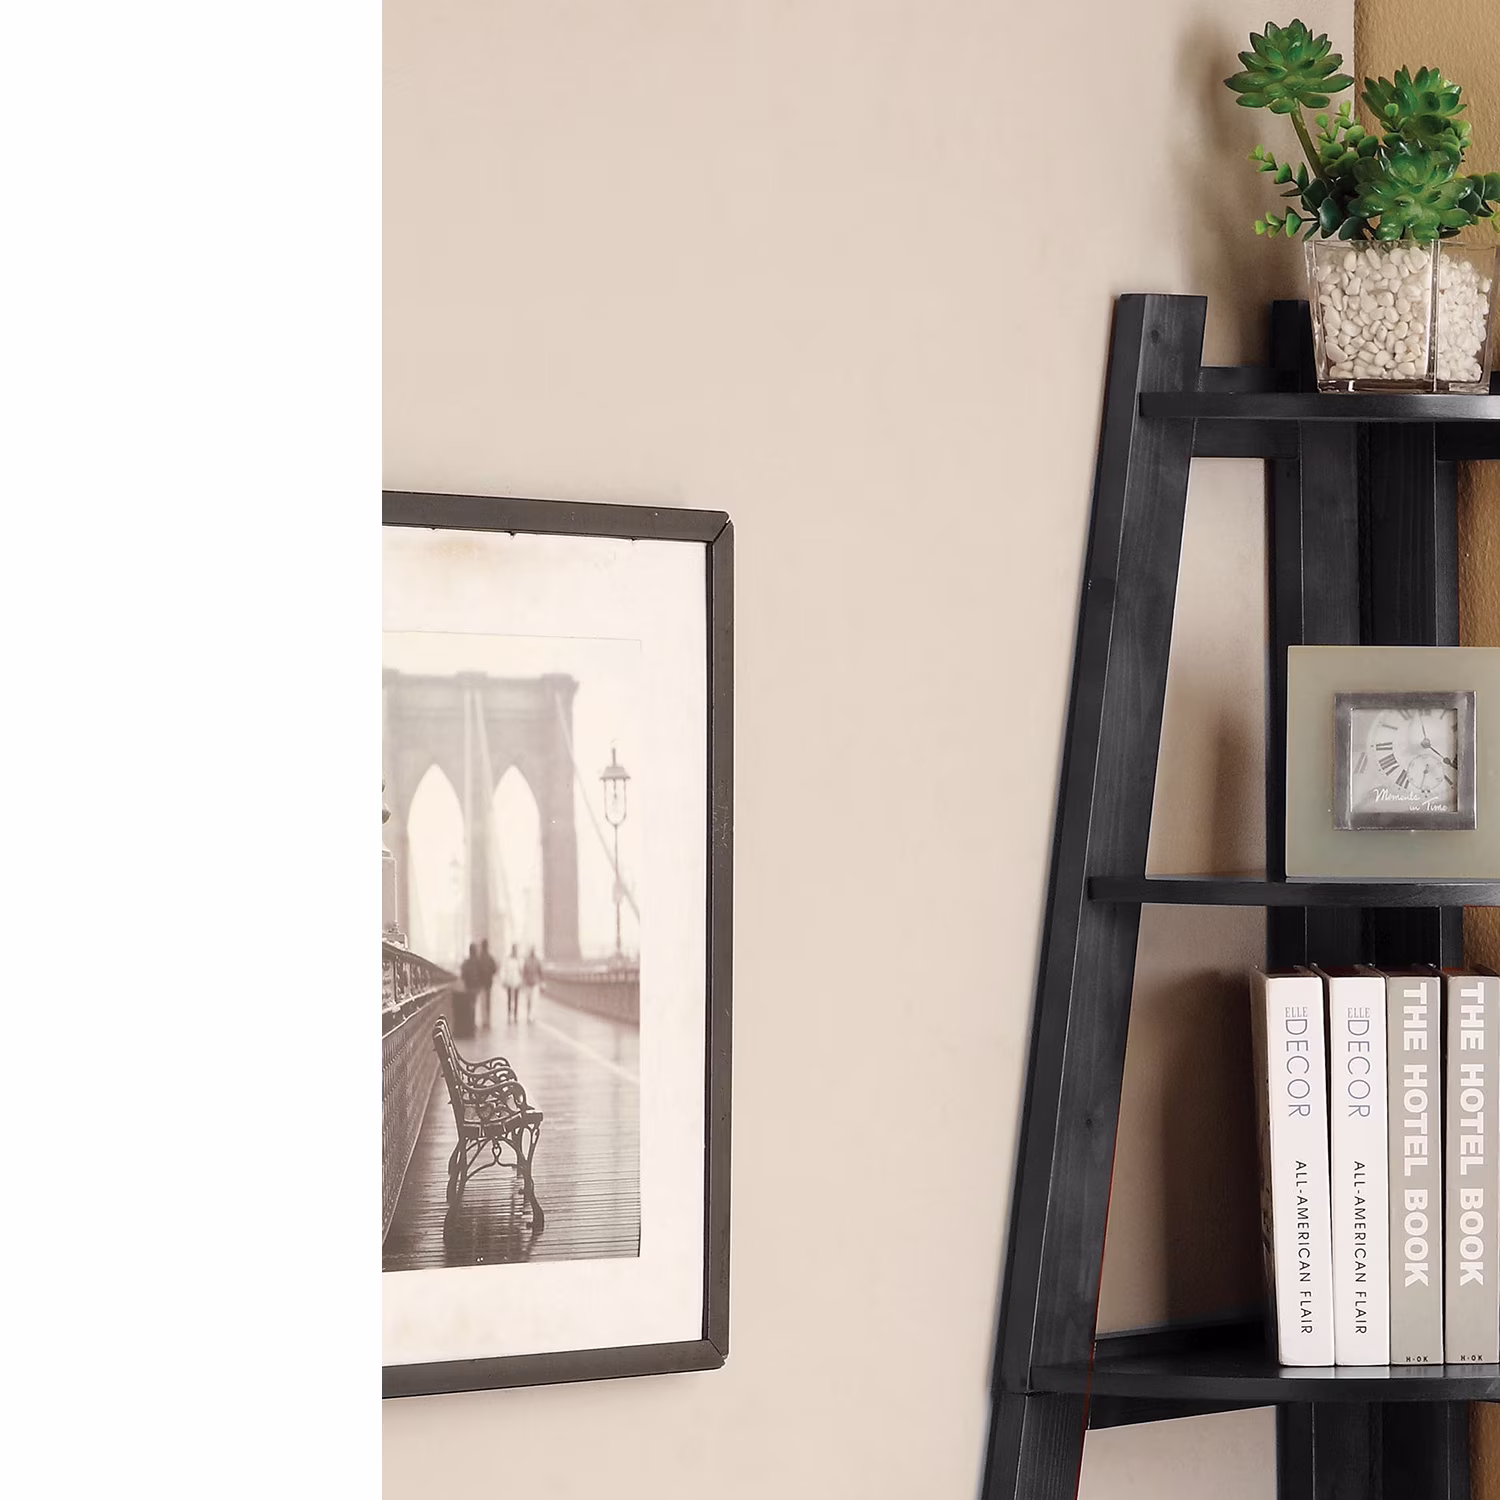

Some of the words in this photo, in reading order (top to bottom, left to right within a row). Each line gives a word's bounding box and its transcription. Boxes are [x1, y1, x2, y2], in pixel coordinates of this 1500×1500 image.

[1422, 796, 1448, 811] Time
[1285, 1007, 1307, 1017] ELLE
[1348, 1008, 1370, 1018] ELLE
[1404, 983, 1427, 1050] THE
[1461, 982, 1484, 1050] THE
[1286, 1019, 1310, 1116] DECOR
[1348, 1020, 1370, 1117] DECOR
[1404, 1065, 1427, 1176] HOTEL
[1461, 1064, 1484, 1175] HOTEL
[1296, 1161, 1310, 1281] ALL-AMERICAN
[1354, 1161, 1366, 1282] ALL-AMERICAN
[1405, 1189, 1428, 1287] BOOK
[1460, 1189, 1483, 1286] BOOK
[1300, 1291, 1312, 1333] FLAIR
[1355, 1292, 1367, 1333] FLAIR
